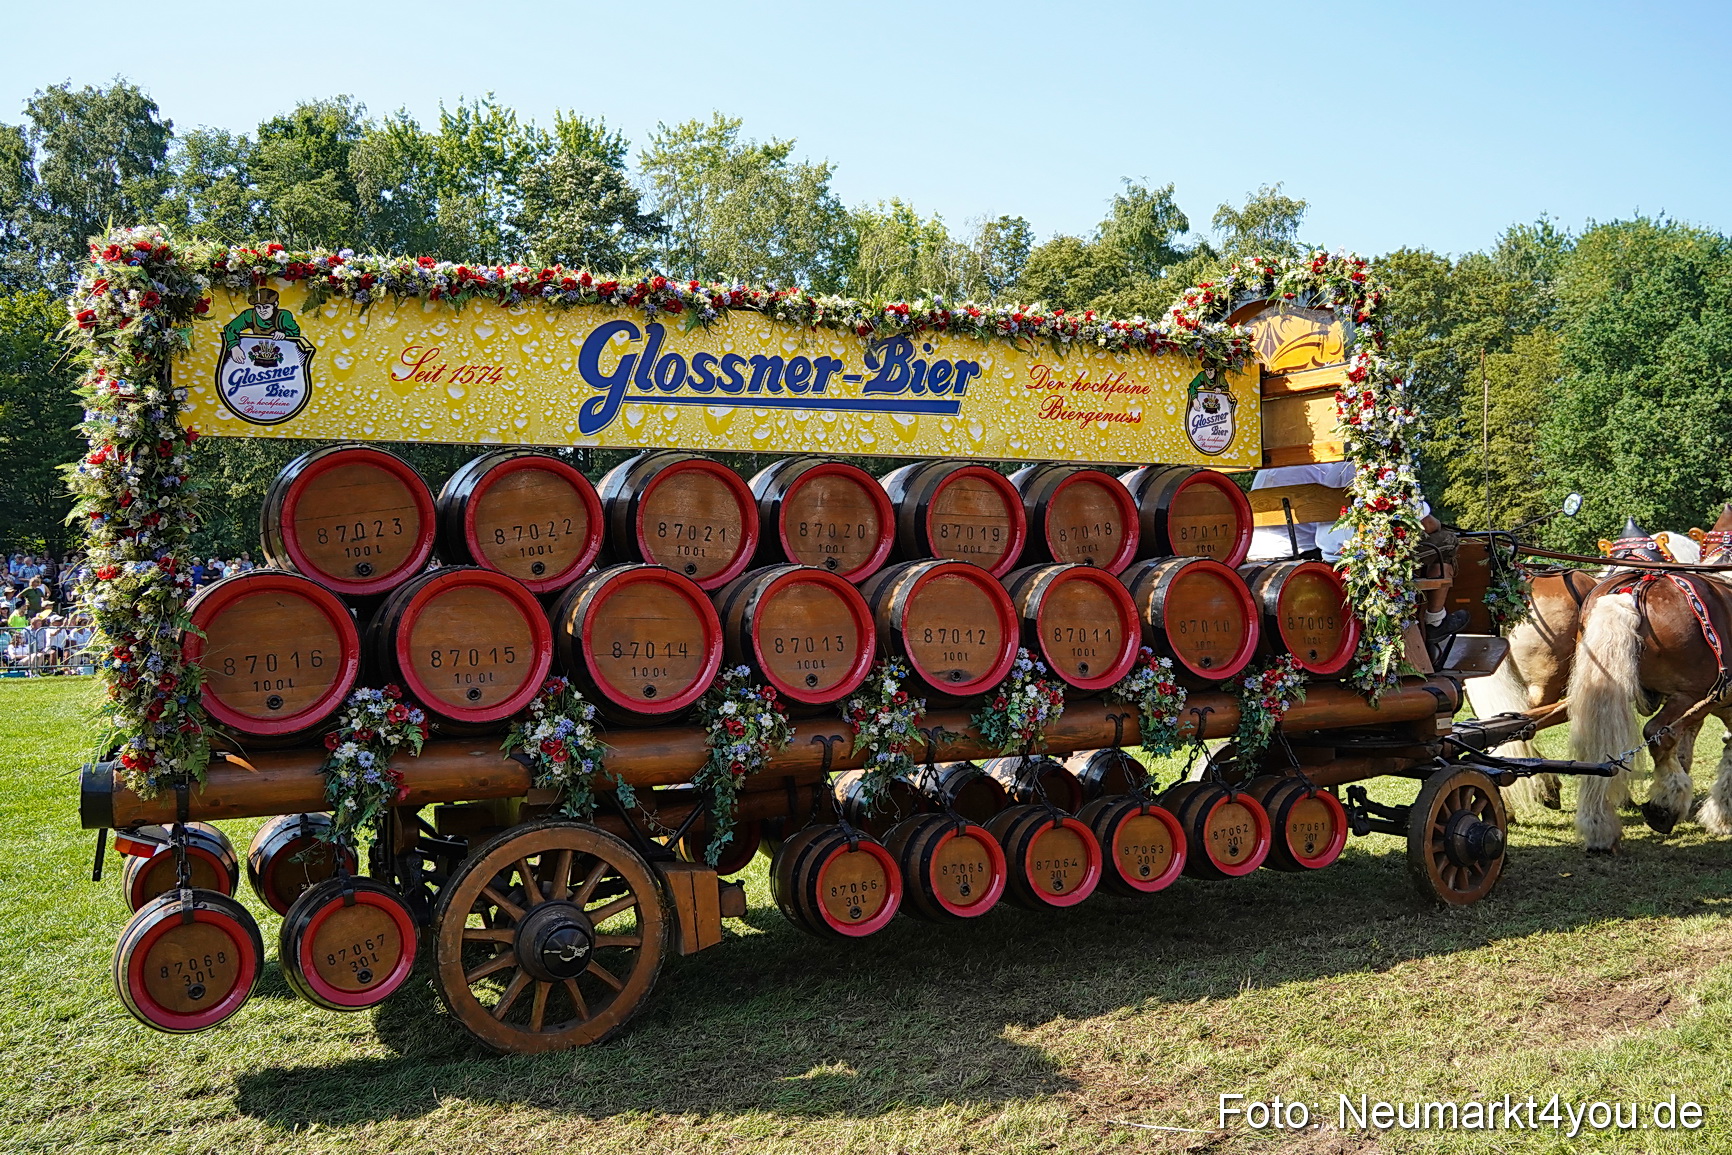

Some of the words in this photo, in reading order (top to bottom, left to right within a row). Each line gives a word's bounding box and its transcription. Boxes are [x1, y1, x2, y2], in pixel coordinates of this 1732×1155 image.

[391, 346, 446, 384] Seit
[448, 365, 504, 385] 1574
[228, 365, 299, 397] Glossner
[578, 319, 982, 435] Glossner-Bier
[1025, 365, 1066, 390] Der
[1072, 371, 1151, 401] hochfeine
[265, 383, 298, 398] Bier
[238, 396, 255, 405] Der
[256, 397, 290, 408] hochfeine
[243, 405, 285, 416] Biergenuss
[1038, 395, 1142, 429] Biergenuss
[1192, 412, 1228, 435] Glossner
[1211, 425, 1228, 436] Bier
[317, 518, 402, 544] 87023
[494, 518, 572, 544] 87022
[658, 522, 727, 542] 87021
[800, 522, 866, 539] 87020
[940, 524, 1000, 542] 87019
[1059, 522, 1112, 542] 87018
[1181, 523, 1229, 540] 87017
[1180, 620, 1230, 634] 87010
[1287, 617, 1334, 630] 87009
[775, 635, 844, 653] 87013
[924, 628, 986, 645] 87012
[1054, 628, 1111, 642] 87011
[430, 646, 516, 668] 87015
[612, 641, 688, 659] 87014
[223, 650, 324, 676] 87016
[1213, 824, 1249, 840] 87062
[1293, 822, 1326, 832] 87061
[1124, 845, 1164, 855] 87063
[942, 862, 984, 875] 87065
[1036, 859, 1078, 871] 87064
[831, 880, 878, 897] 87066
[327, 933, 385, 966] 87067
[160, 951, 227, 979] 87068
